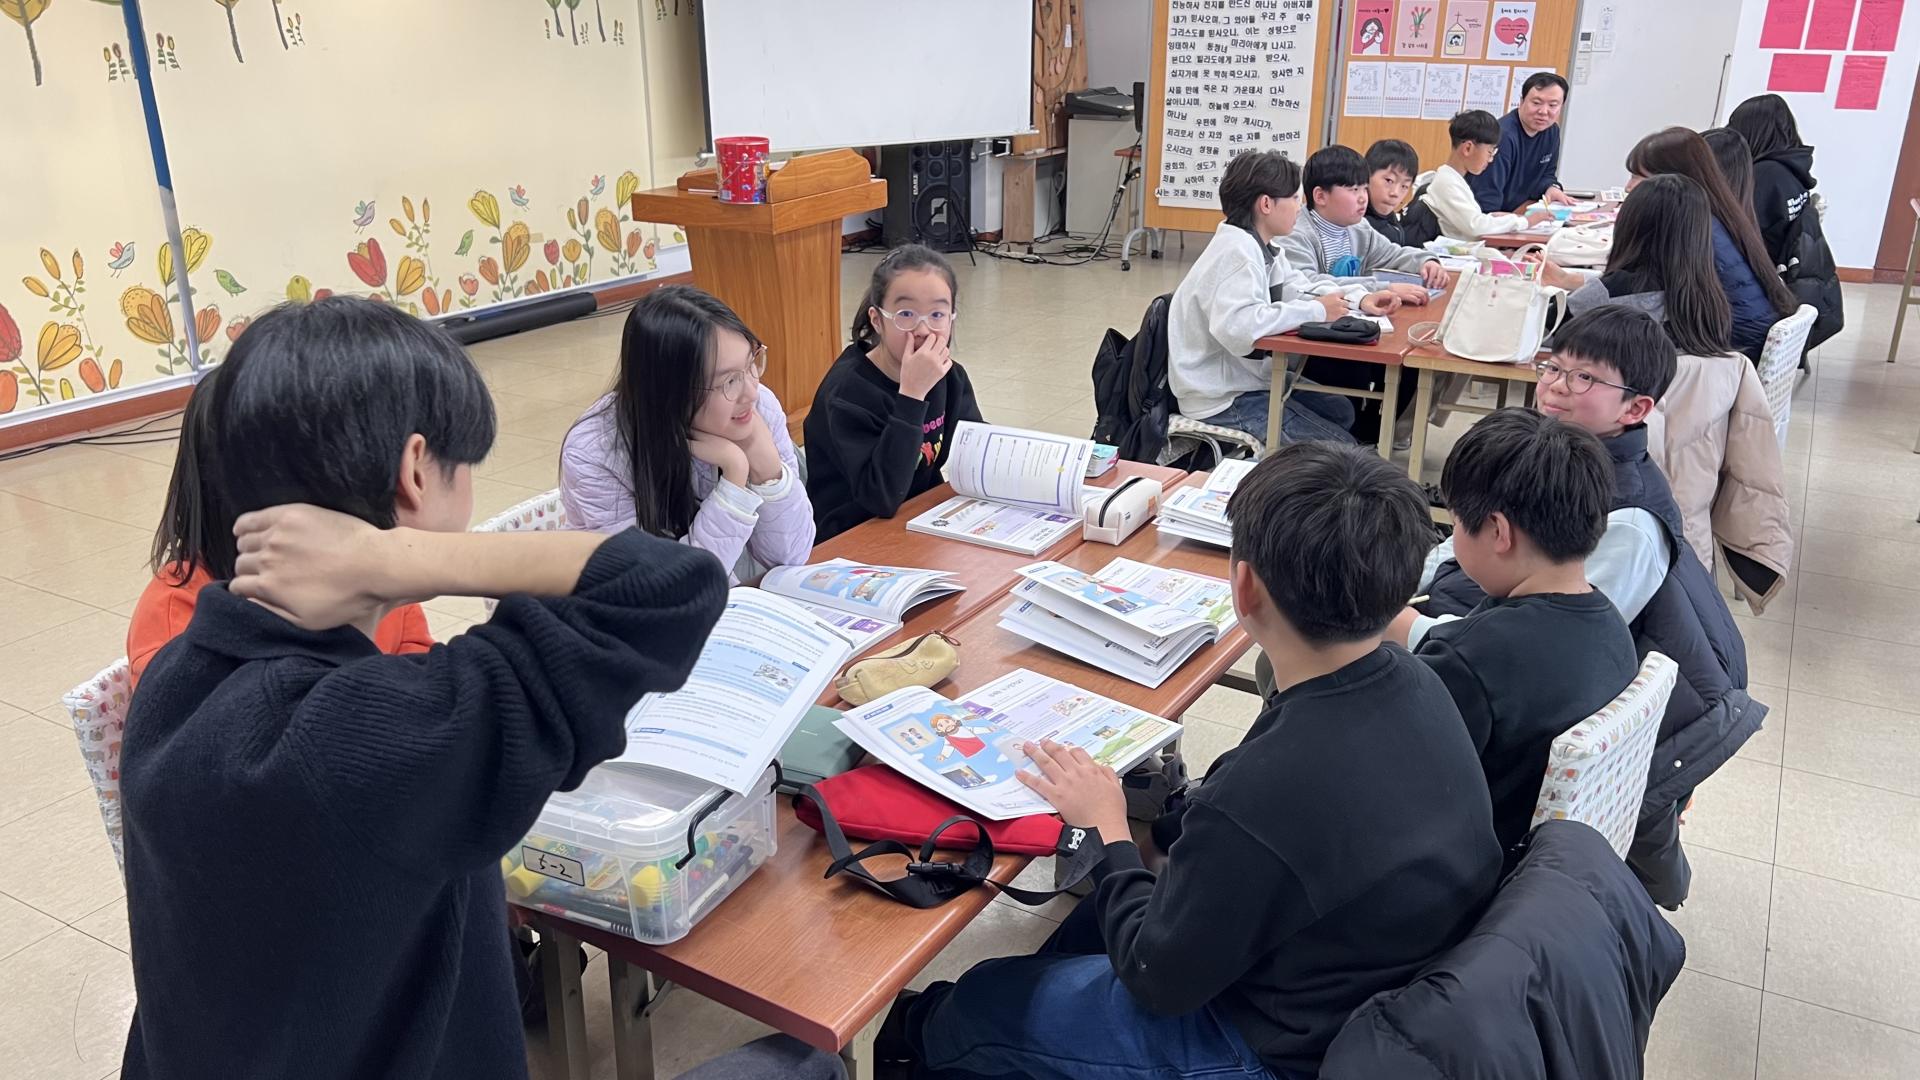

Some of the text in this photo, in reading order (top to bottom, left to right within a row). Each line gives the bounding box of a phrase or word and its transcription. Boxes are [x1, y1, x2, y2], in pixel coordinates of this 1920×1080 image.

[1255, 0, 1277, 8] 하나님
[1283, 0, 1313, 9] 아버지를
[1173, 15, 1187, 23] 내가
[1223, 16, 1230, 24] 그
[1261, 12, 1275, 20] 우리
[1280, 12, 1287, 20] 주
[1296, 13, 1311, 21] 예수
[1170, 28, 1205, 37] 그리스도를
[1245, 27, 1259, 35] 이는
[1268, 25, 1296, 35] 성령으로
[1231, 39, 1267, 50] 마리아에게
[1172, 55, 1192, 64] 본디오
[1196, 55, 1232, 64] 빌라도에게
[1235, 55, 1256, 63] 고난을
[1171, 69, 1198, 78] 십자가에
[1203, 69, 1210, 77] 못
[1271, 68, 1293, 78] 장사한
[1168, 84, 1284, 94] 사흘 만에 죽은 자 가운데서 다시
[1208, 102, 1229, 110] 하늘에
[1167, 110, 1187, 120] 하나님
[1195, 118, 1216, 126] 우편에
[1198, 130, 1205, 139] 산
[1208, 131, 1222, 139] 자와
[1229, 134, 1243, 142] 죽은
[1247, 132, 1260, 140] 자를
[1196, 160, 1216, 170] 성도가
[1184, 174, 1204, 184] 사하여
[1157, 188, 1169, 197] 사는
[1192, 190, 1213, 199] 영원히
[538, 853, 573, 879] 5-2
